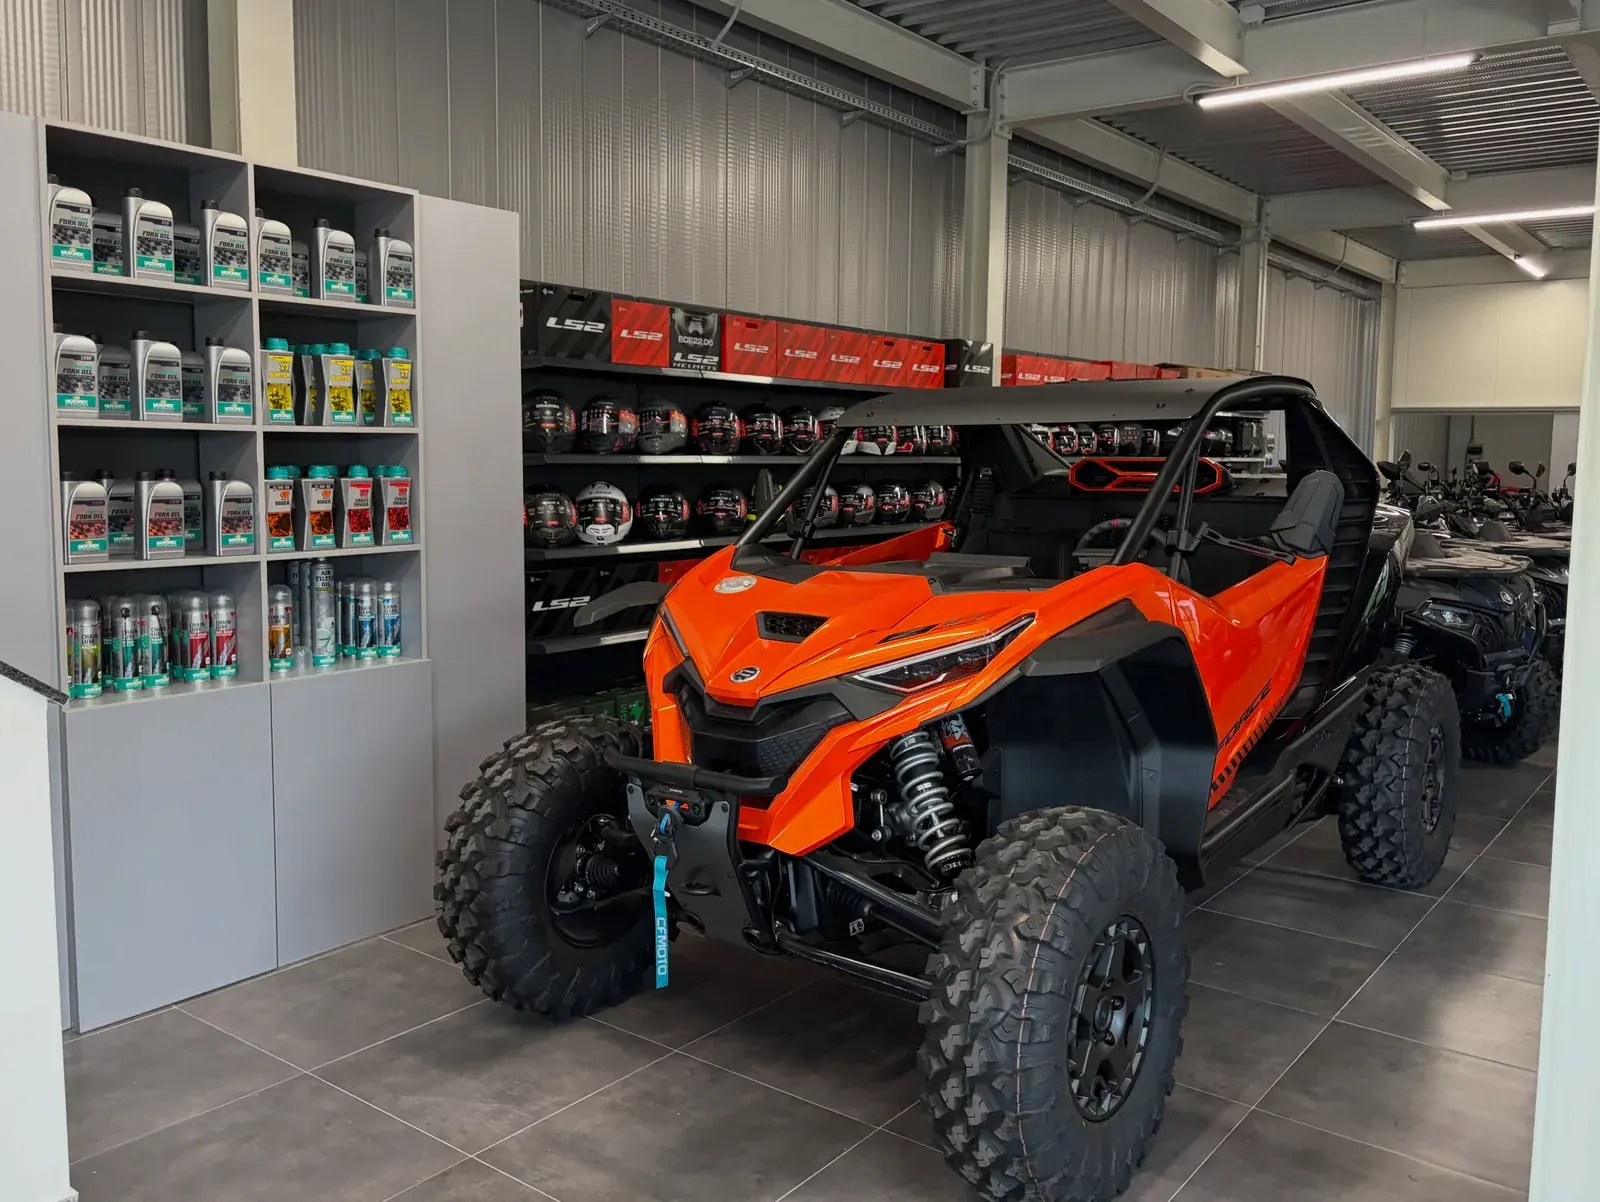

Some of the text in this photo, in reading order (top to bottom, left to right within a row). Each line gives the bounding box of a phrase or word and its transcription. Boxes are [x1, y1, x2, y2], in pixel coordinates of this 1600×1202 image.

[546, 317, 606, 334] LS2
[620, 329, 663, 342] LS2
[734, 342, 769, 354] LS2
[785, 348, 818, 360] LS2
[674, 352, 719, 365] LS2
[831, 354, 861, 364] LS2
[872, 360, 903, 370] LS2
[912, 364, 940, 373] LS2
[964, 364, 990, 374] LS2
[532, 596, 590, 612] LS2
[656, 916, 668, 976] CFMOTO
